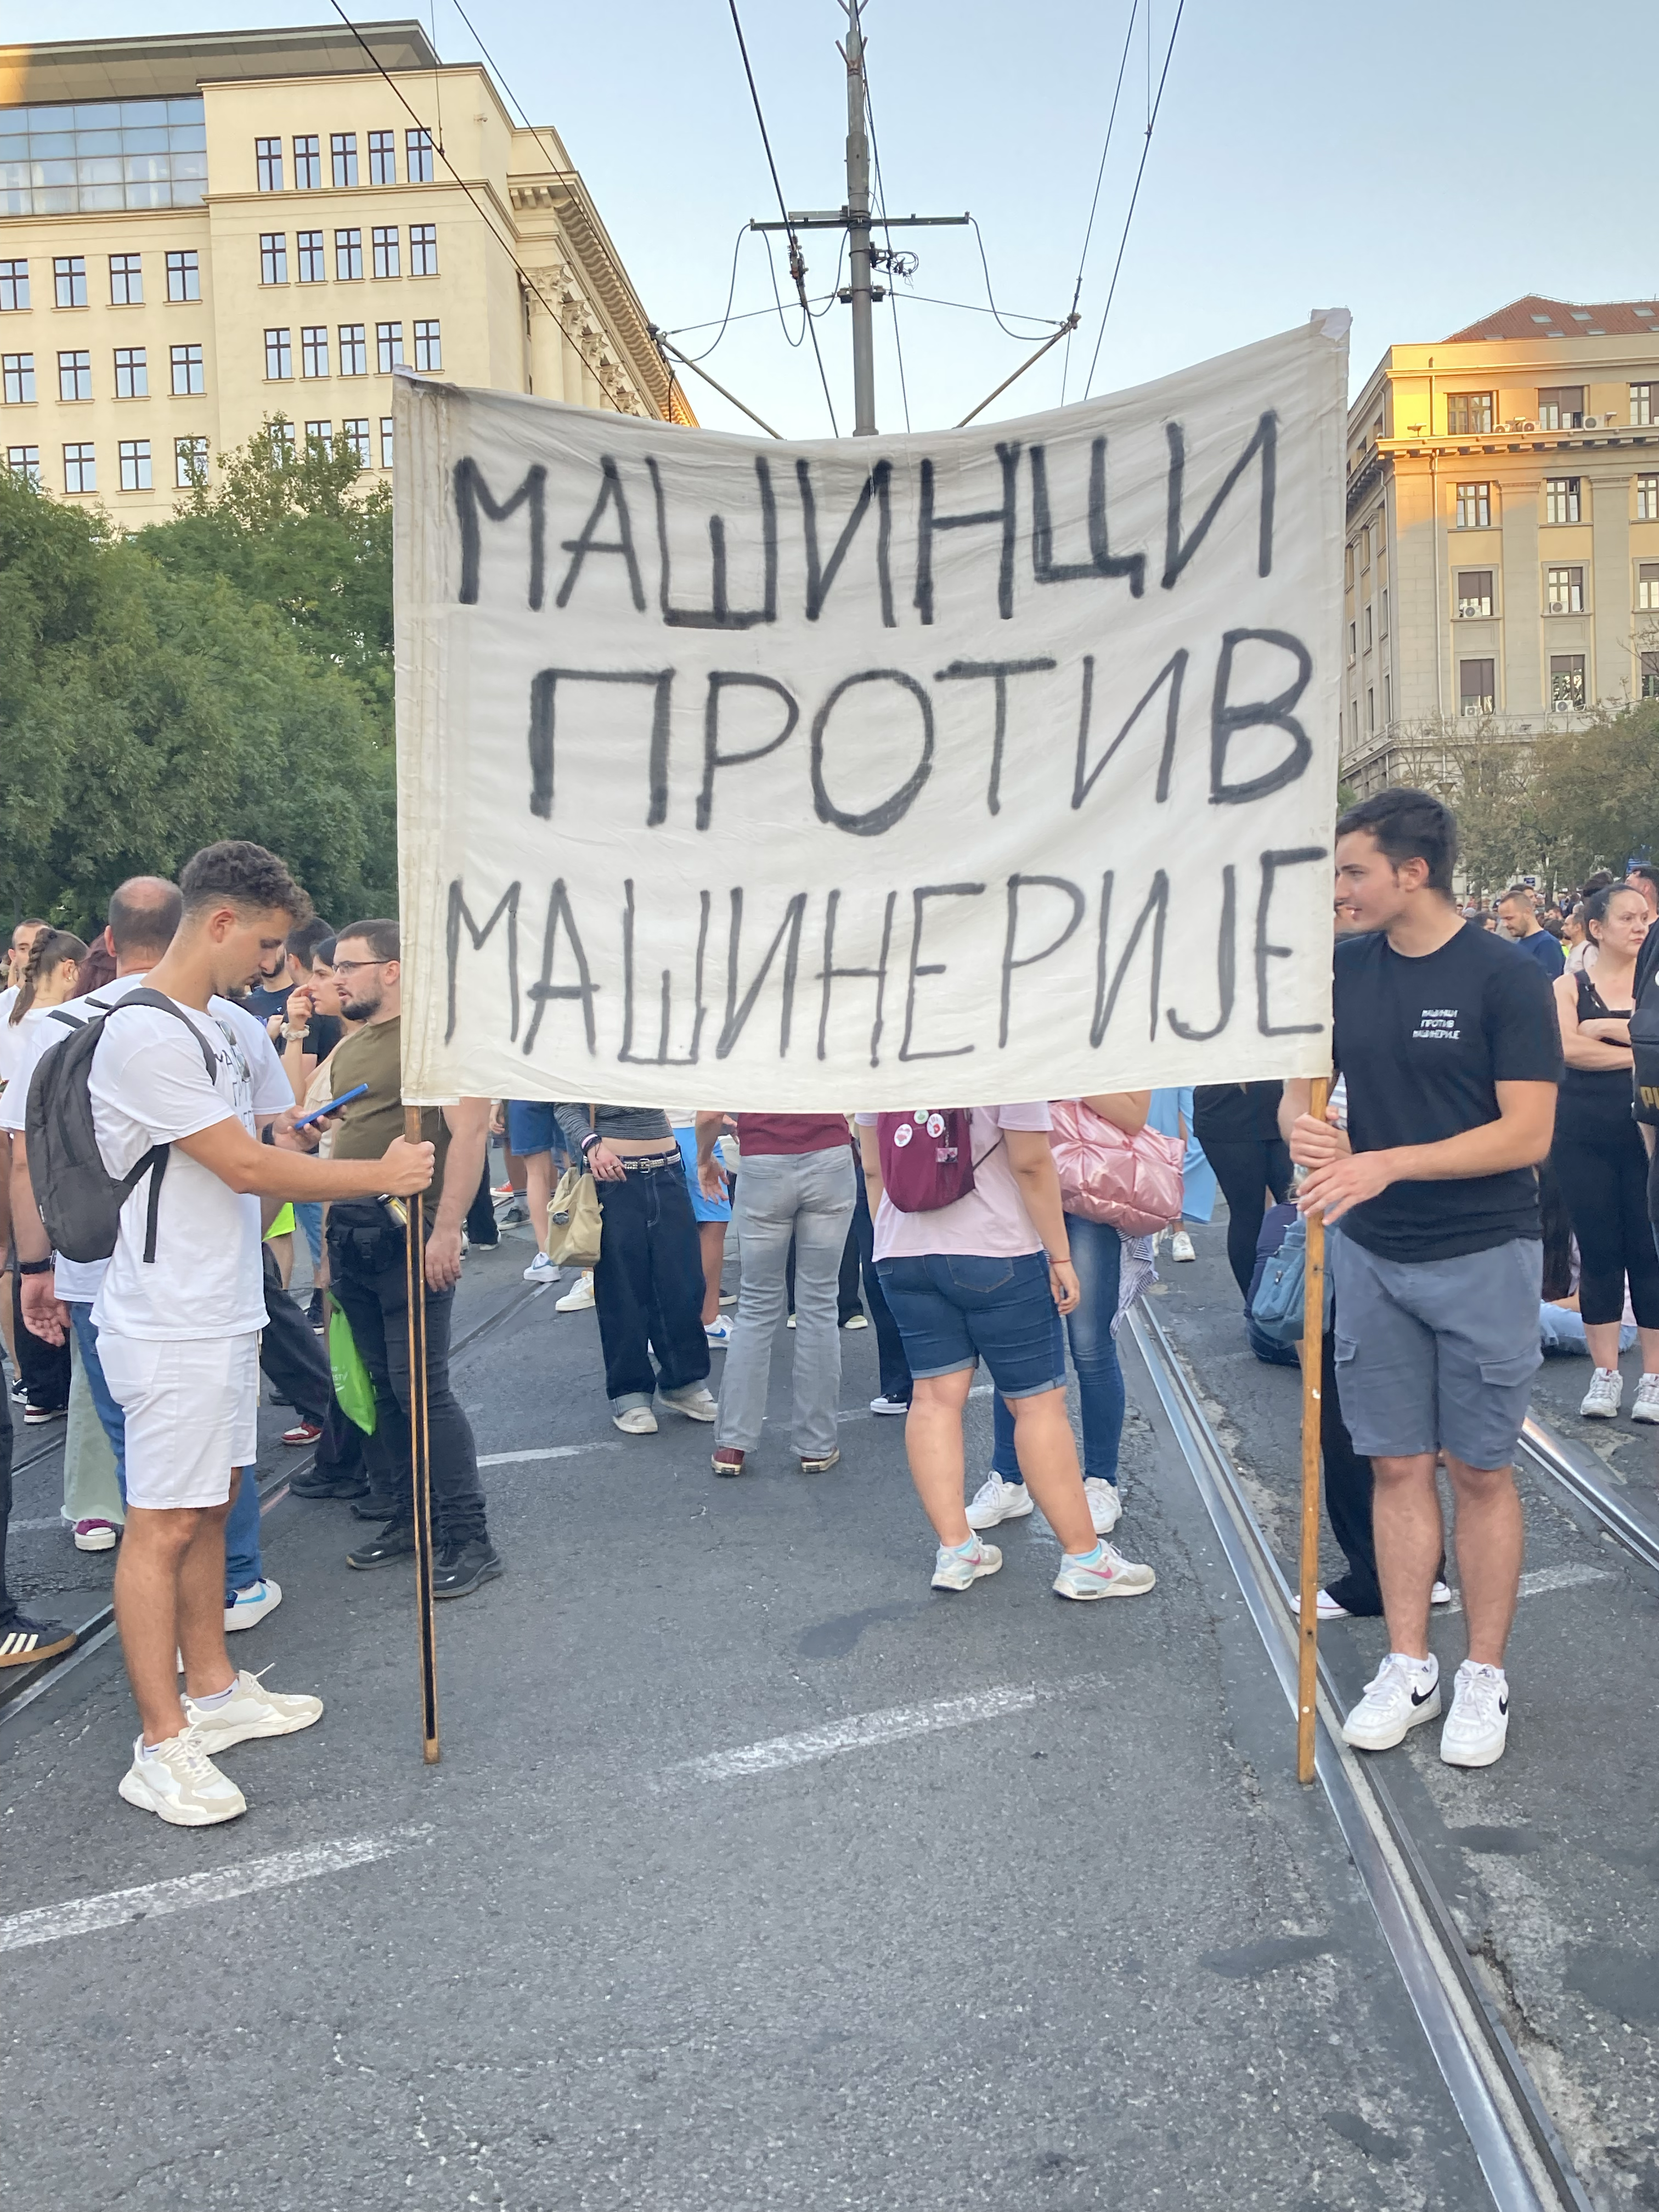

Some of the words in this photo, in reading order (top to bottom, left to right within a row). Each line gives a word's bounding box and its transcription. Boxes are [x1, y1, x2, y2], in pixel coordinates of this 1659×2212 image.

[453, 410, 1277, 628] МАШИНЦИ
[529, 629, 1313, 836] ПРОТИВ
[445, 848, 1328, 1066] МАШИНЕРИЈЕ
